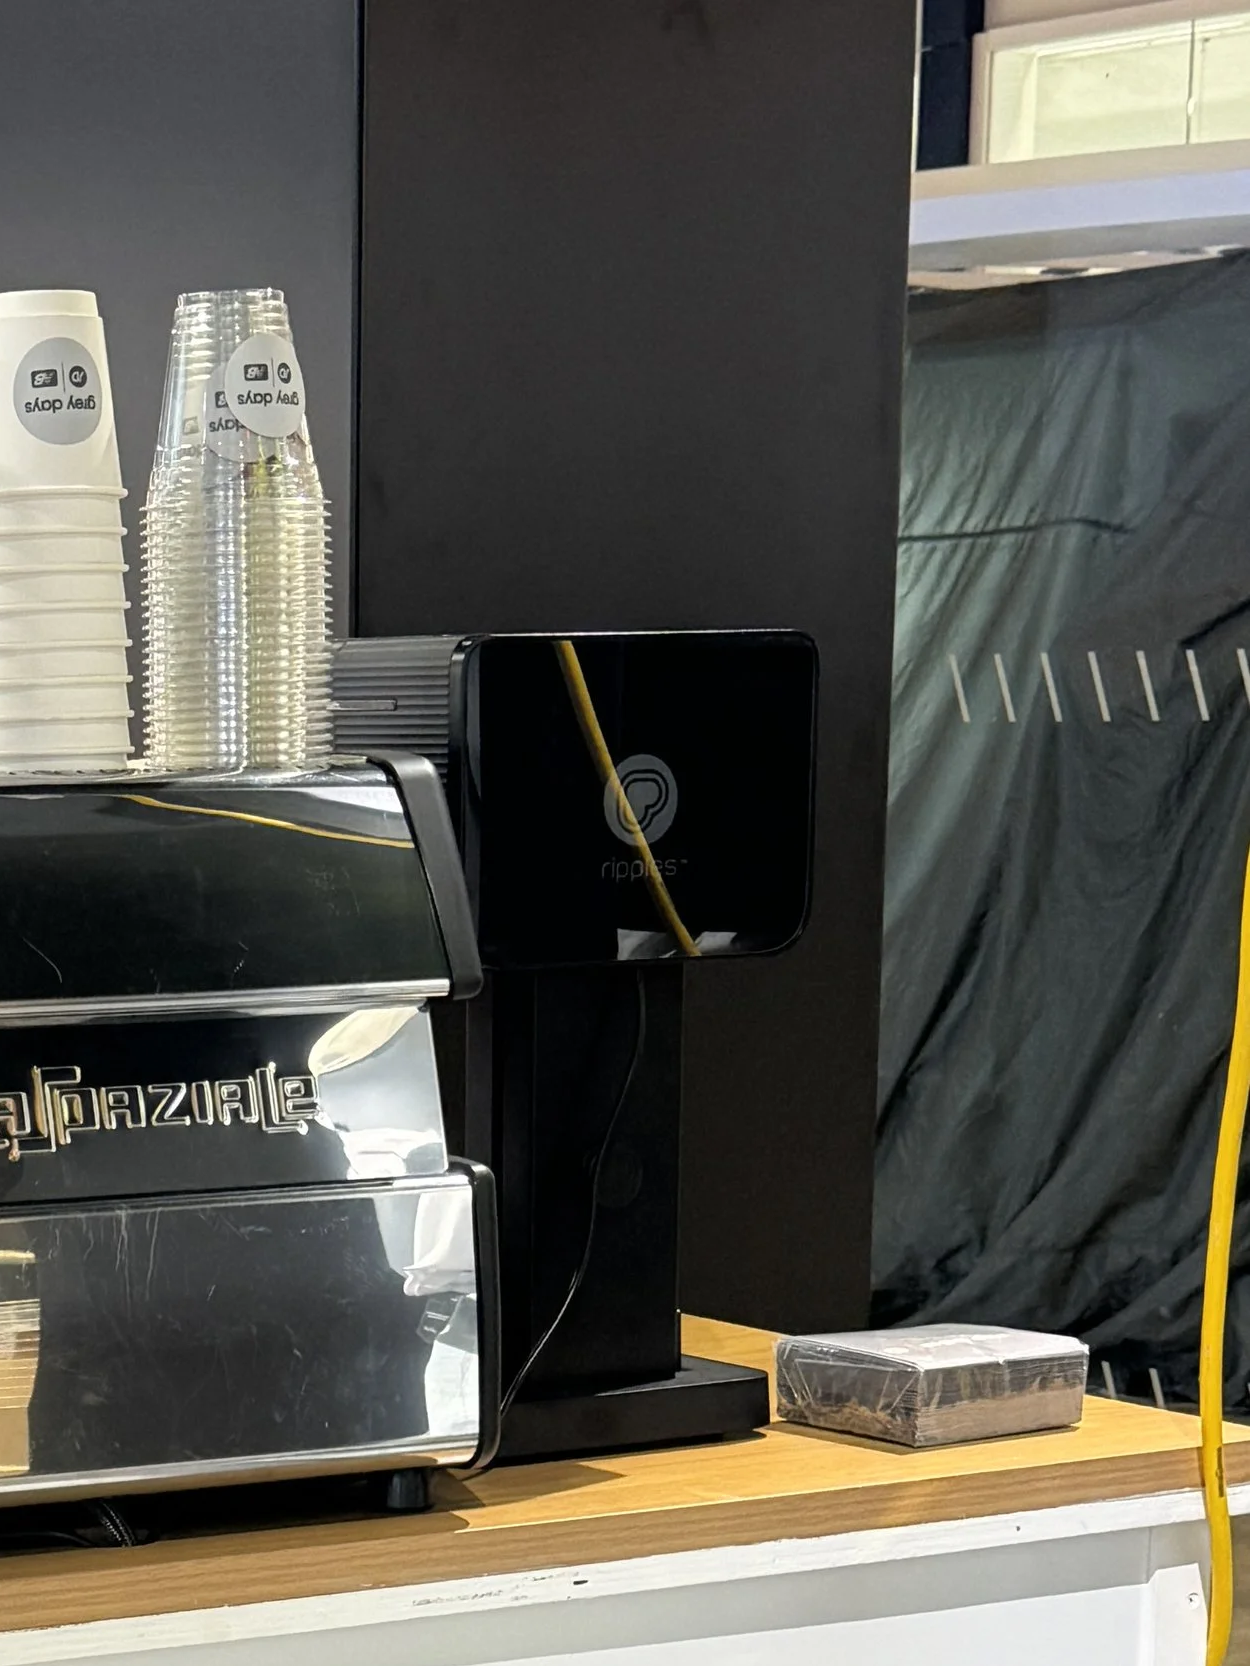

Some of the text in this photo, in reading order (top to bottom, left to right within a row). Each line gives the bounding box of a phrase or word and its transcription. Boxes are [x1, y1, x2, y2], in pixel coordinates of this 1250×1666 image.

[24, 395, 96, 413] grey days
[237, 392, 273, 406] days
[276, 390, 299, 405] grey
